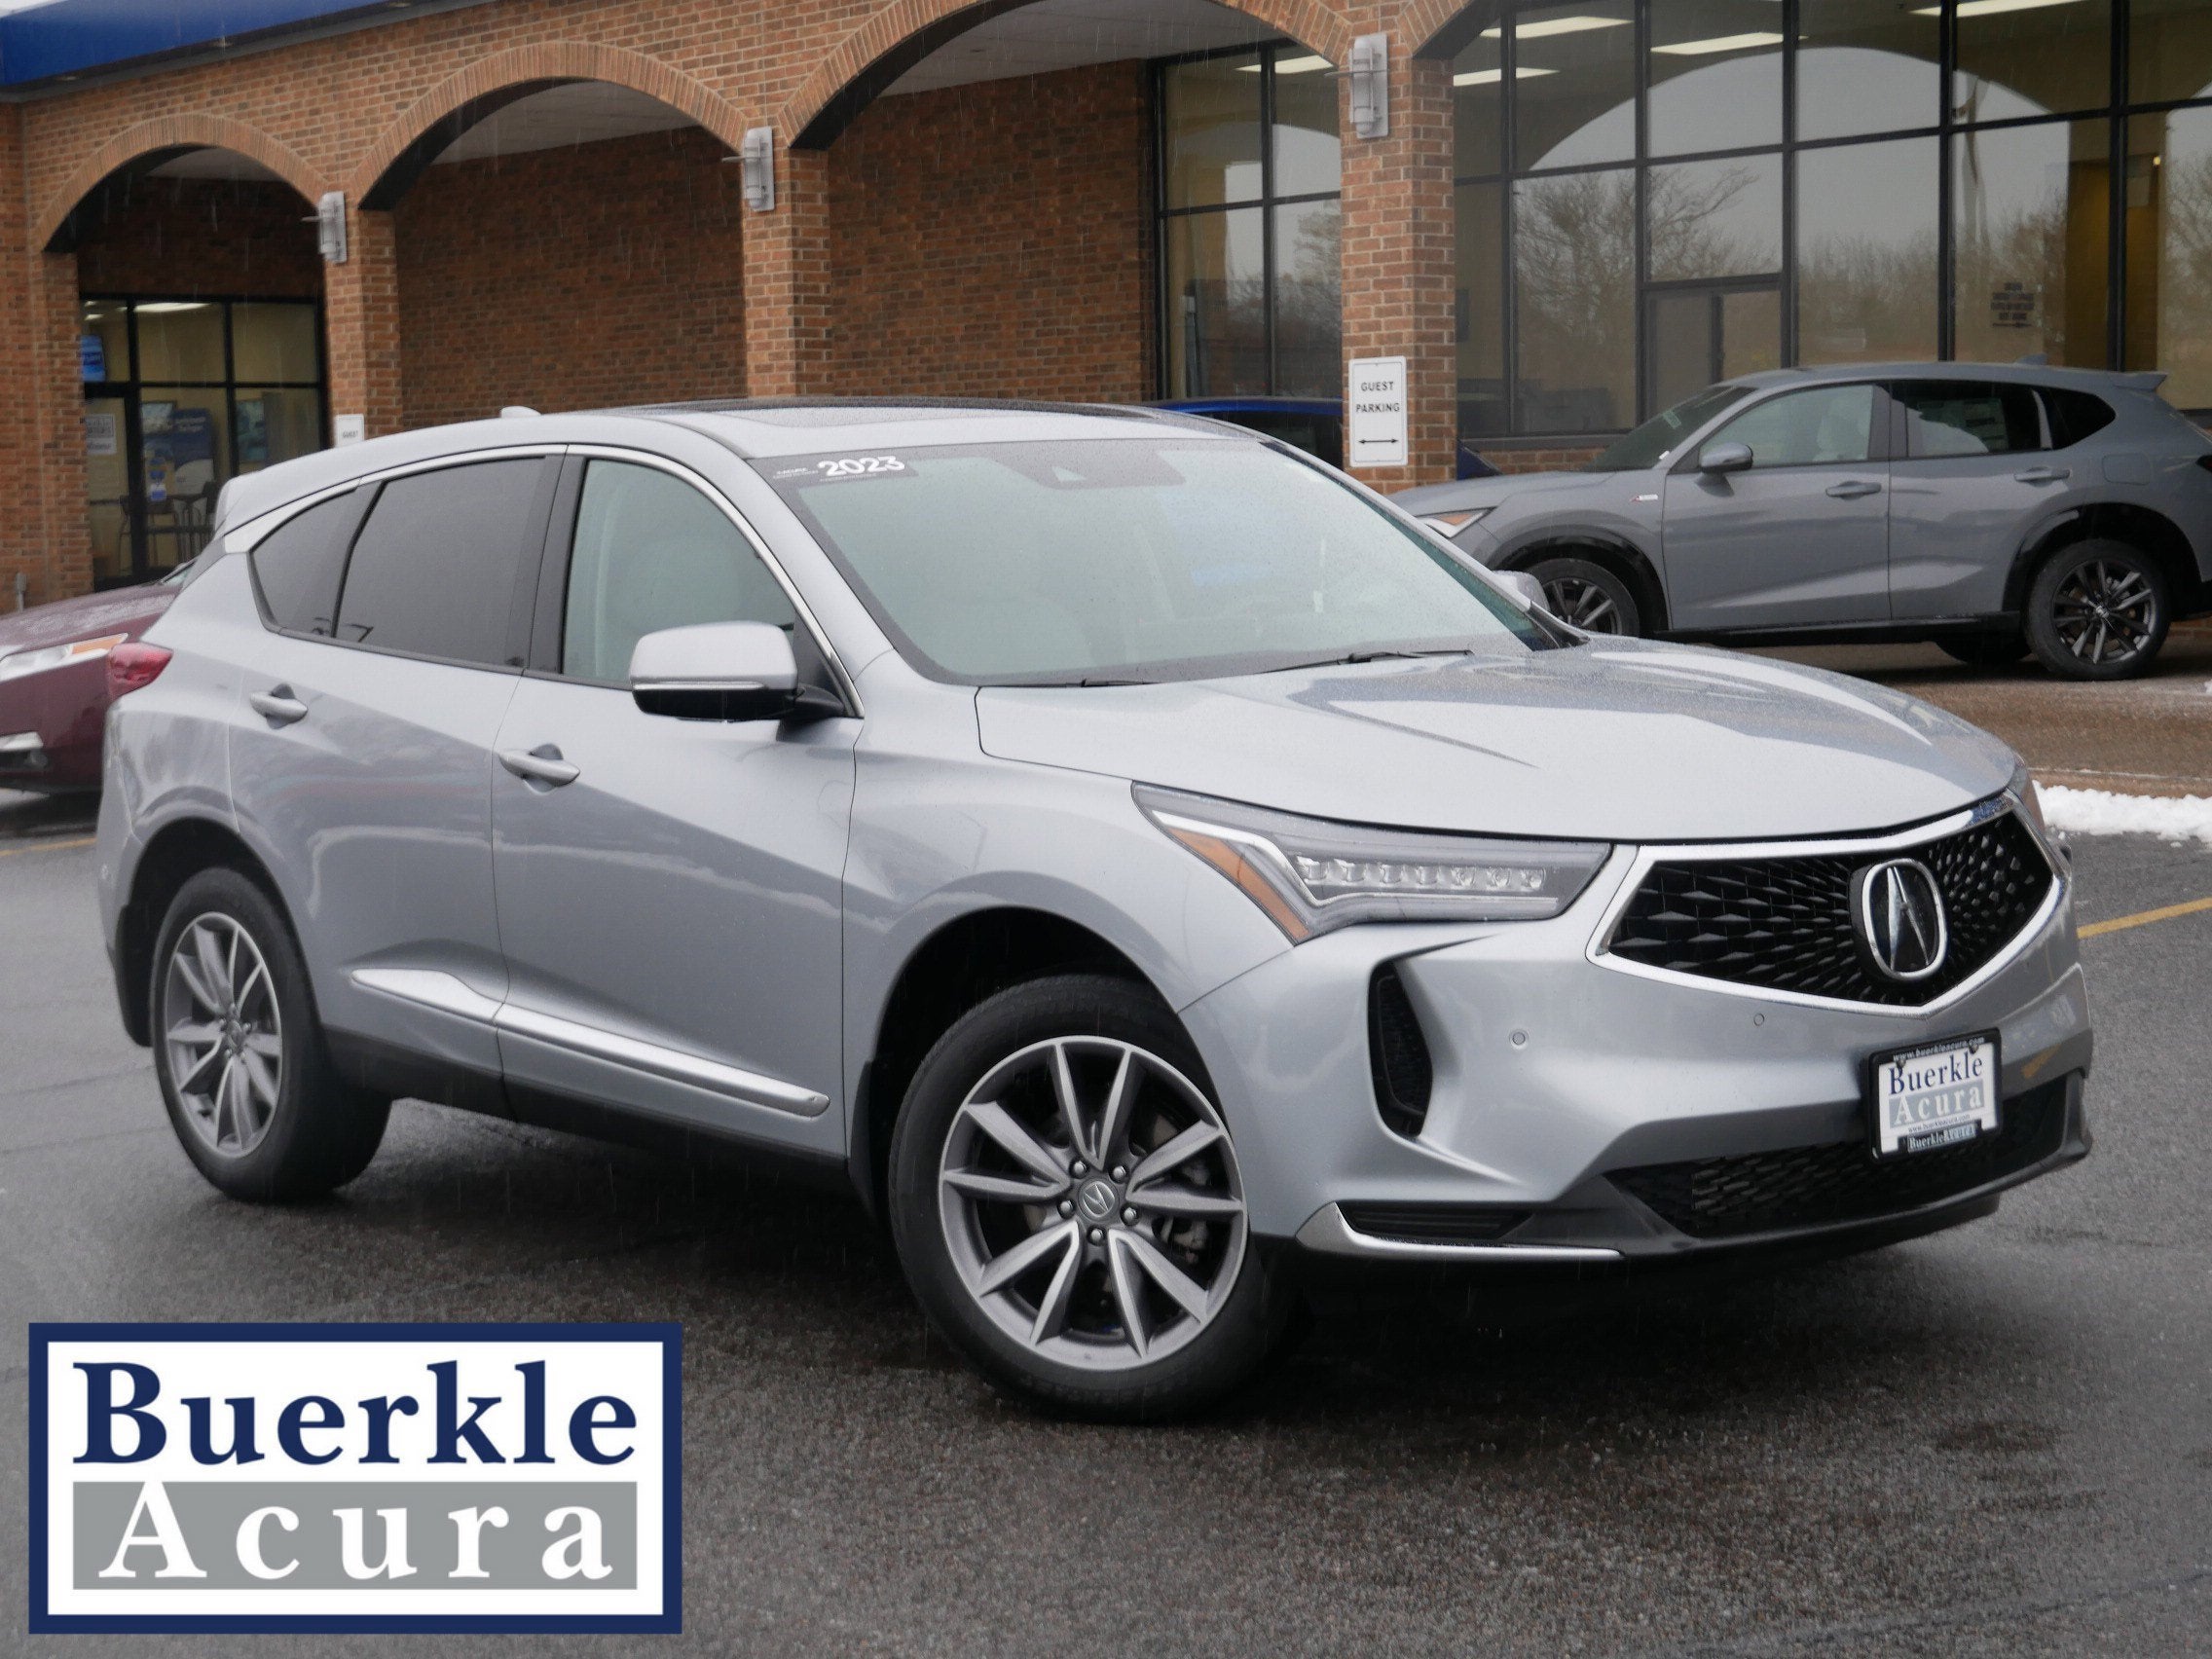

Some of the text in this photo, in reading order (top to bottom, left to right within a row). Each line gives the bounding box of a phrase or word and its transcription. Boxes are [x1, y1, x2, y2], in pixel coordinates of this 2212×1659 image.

[1360, 381, 1394, 392] GUEST
[1355, 402, 1400, 413] PARKING
[817, 455, 905, 477] 2023
[1888, 1051, 1983, 1095] Buerkle
[1894, 1086, 1982, 1125] Acura
